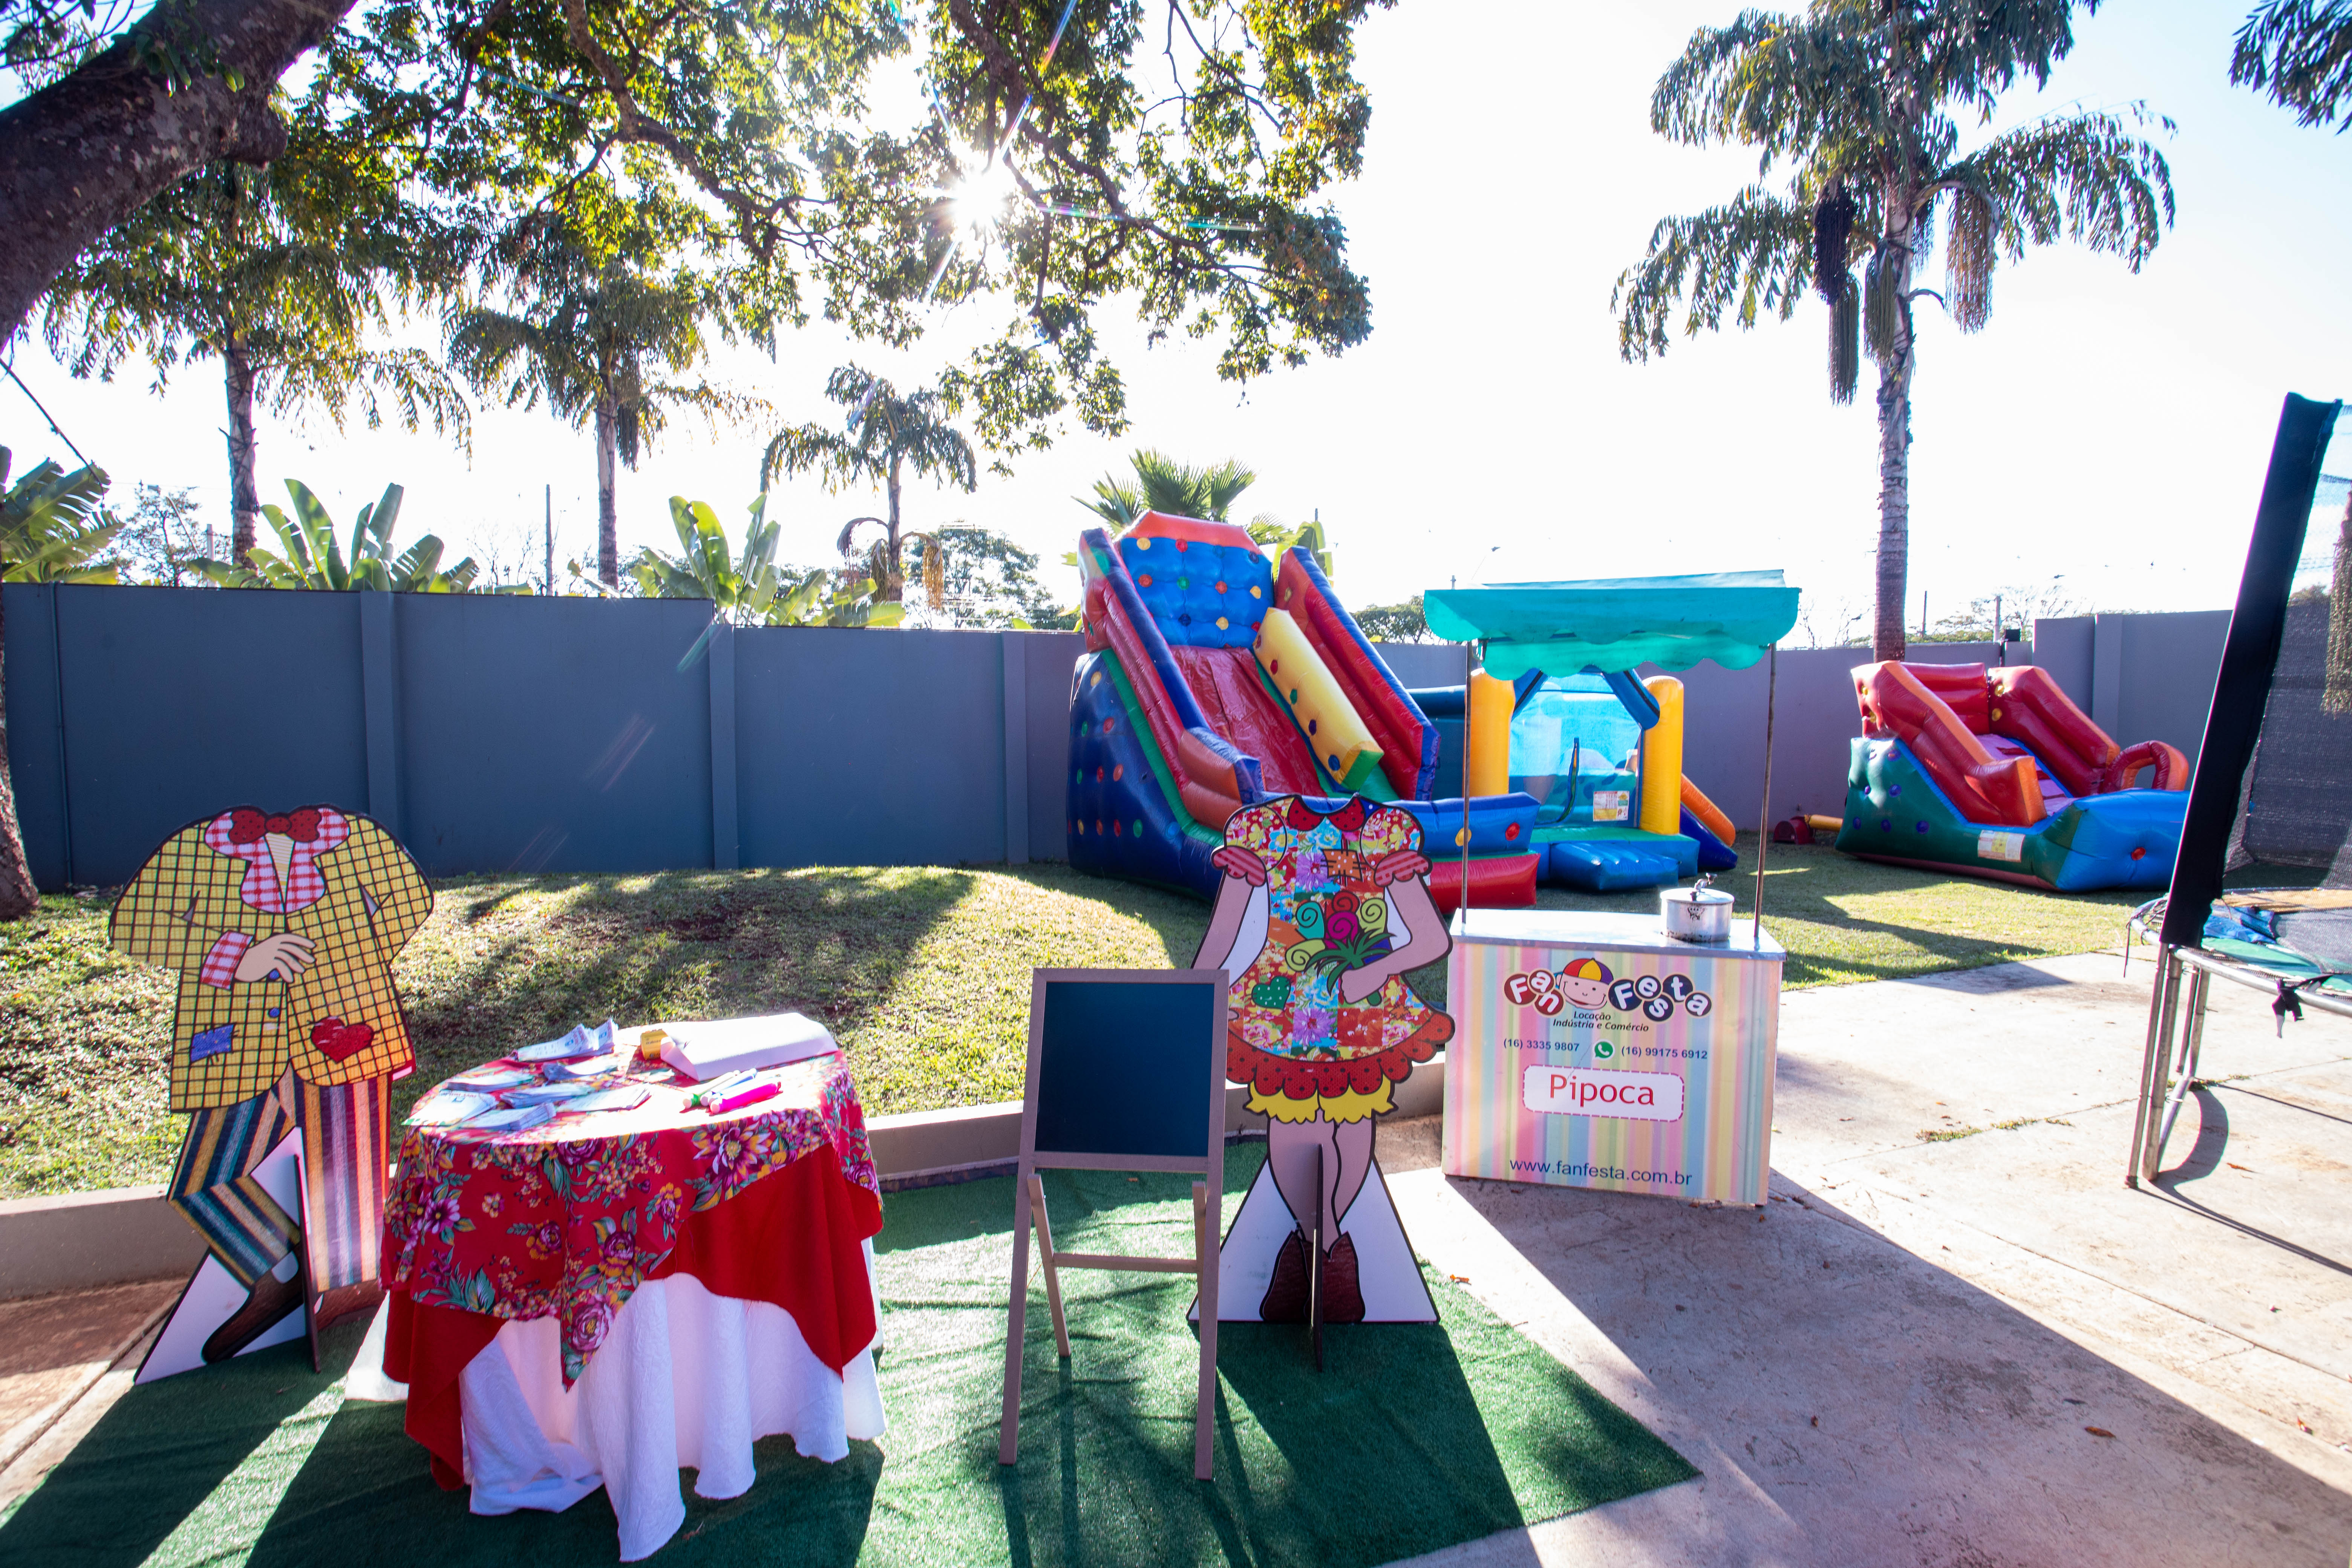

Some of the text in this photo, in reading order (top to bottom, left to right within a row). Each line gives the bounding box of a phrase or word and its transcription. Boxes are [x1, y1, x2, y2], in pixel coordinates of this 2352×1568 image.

[1510, 971, 1709, 1017] Fan Festa
[1573, 1011, 1611, 1021] Locação
[1553, 1018, 1594, 1029] Indústria
[1605, 1021, 1649, 1032] Comércio
[1503, 1038, 1580, 1052] (16) 3335 9807
[1621, 1046, 1707, 1060] (16) 99175 6912
[1550, 1073, 1655, 1108] Pipoca
[1510, 1160, 1693, 1185] www.fanfesta.com.br
